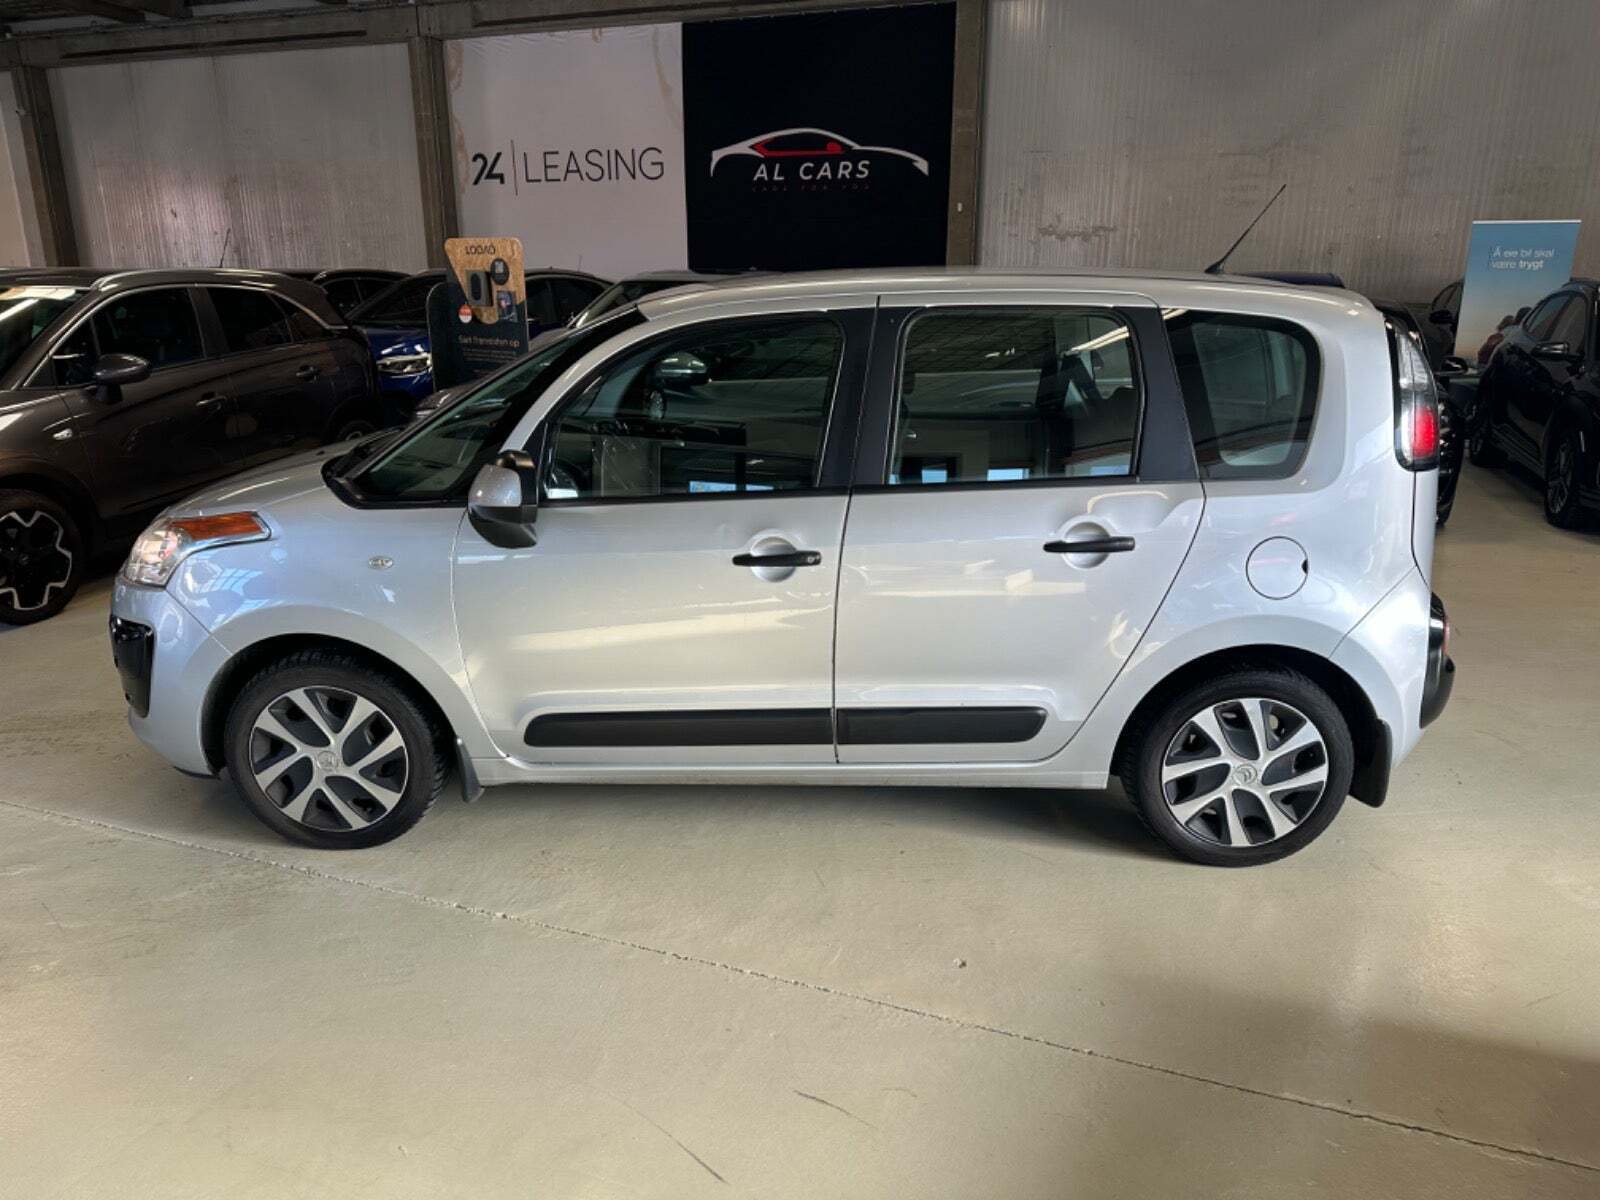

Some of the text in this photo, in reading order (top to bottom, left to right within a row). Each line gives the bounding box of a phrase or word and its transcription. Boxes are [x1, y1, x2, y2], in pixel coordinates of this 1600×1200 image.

[472, 147, 665, 186] 24 LEASING
[753, 160, 870, 181] AL CARS
[1534, 247, 1555, 258] skal
[1518, 259, 1544, 271] trygt
